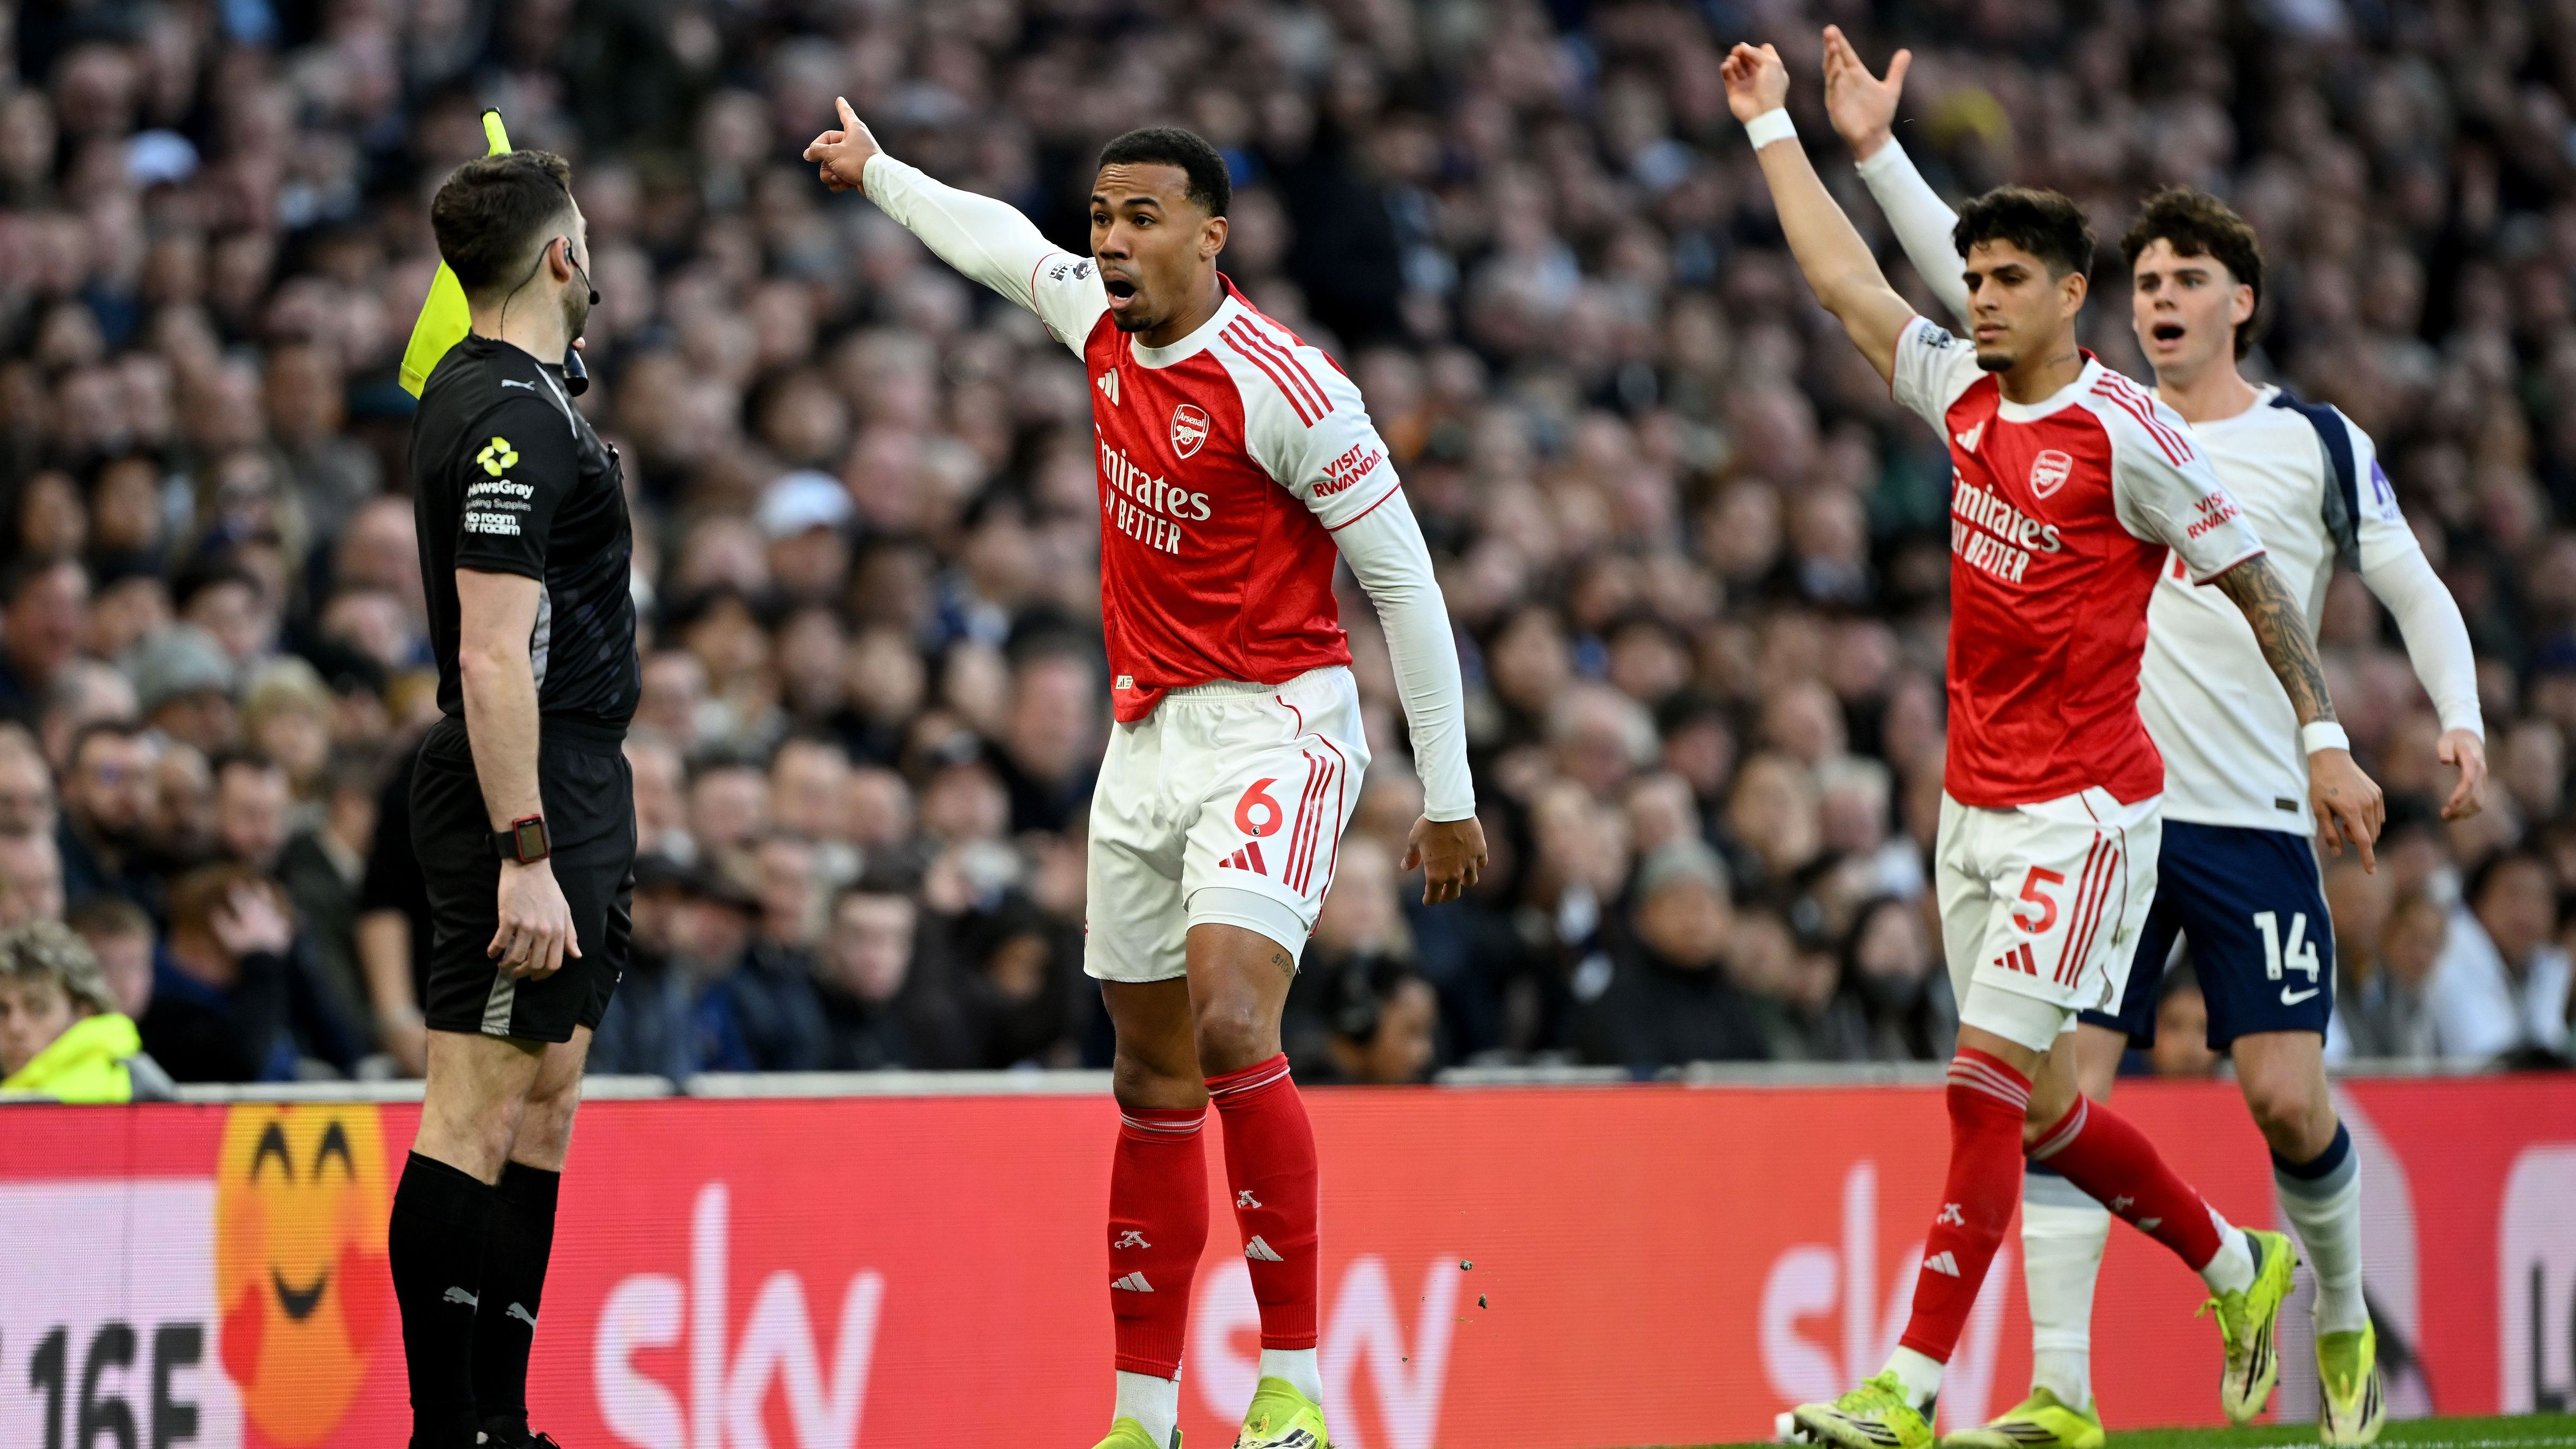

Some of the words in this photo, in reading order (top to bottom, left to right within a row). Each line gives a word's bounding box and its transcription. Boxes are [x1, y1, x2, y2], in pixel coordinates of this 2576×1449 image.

[1178, 412, 1204, 427] Arsenal
[1096, 422, 1211, 521] mirates
[1313, 449, 1382, 498] RWANDA
[1322, 443, 1363, 478] VISIT
[479, 522, 521, 536] racism
[480, 513, 516, 526] room
[493, 498, 531, 512] Supplies
[1117, 498, 1181, 555] BETTER
[2187, 504, 2240, 539] RWAN
[1963, 530, 2030, 580] BETTER
[1234, 778, 1283, 837] 6
[2012, 865, 2066, 935] 5
[2253, 910, 2320, 984] 14
[590, 1178, 887, 1449] sky
